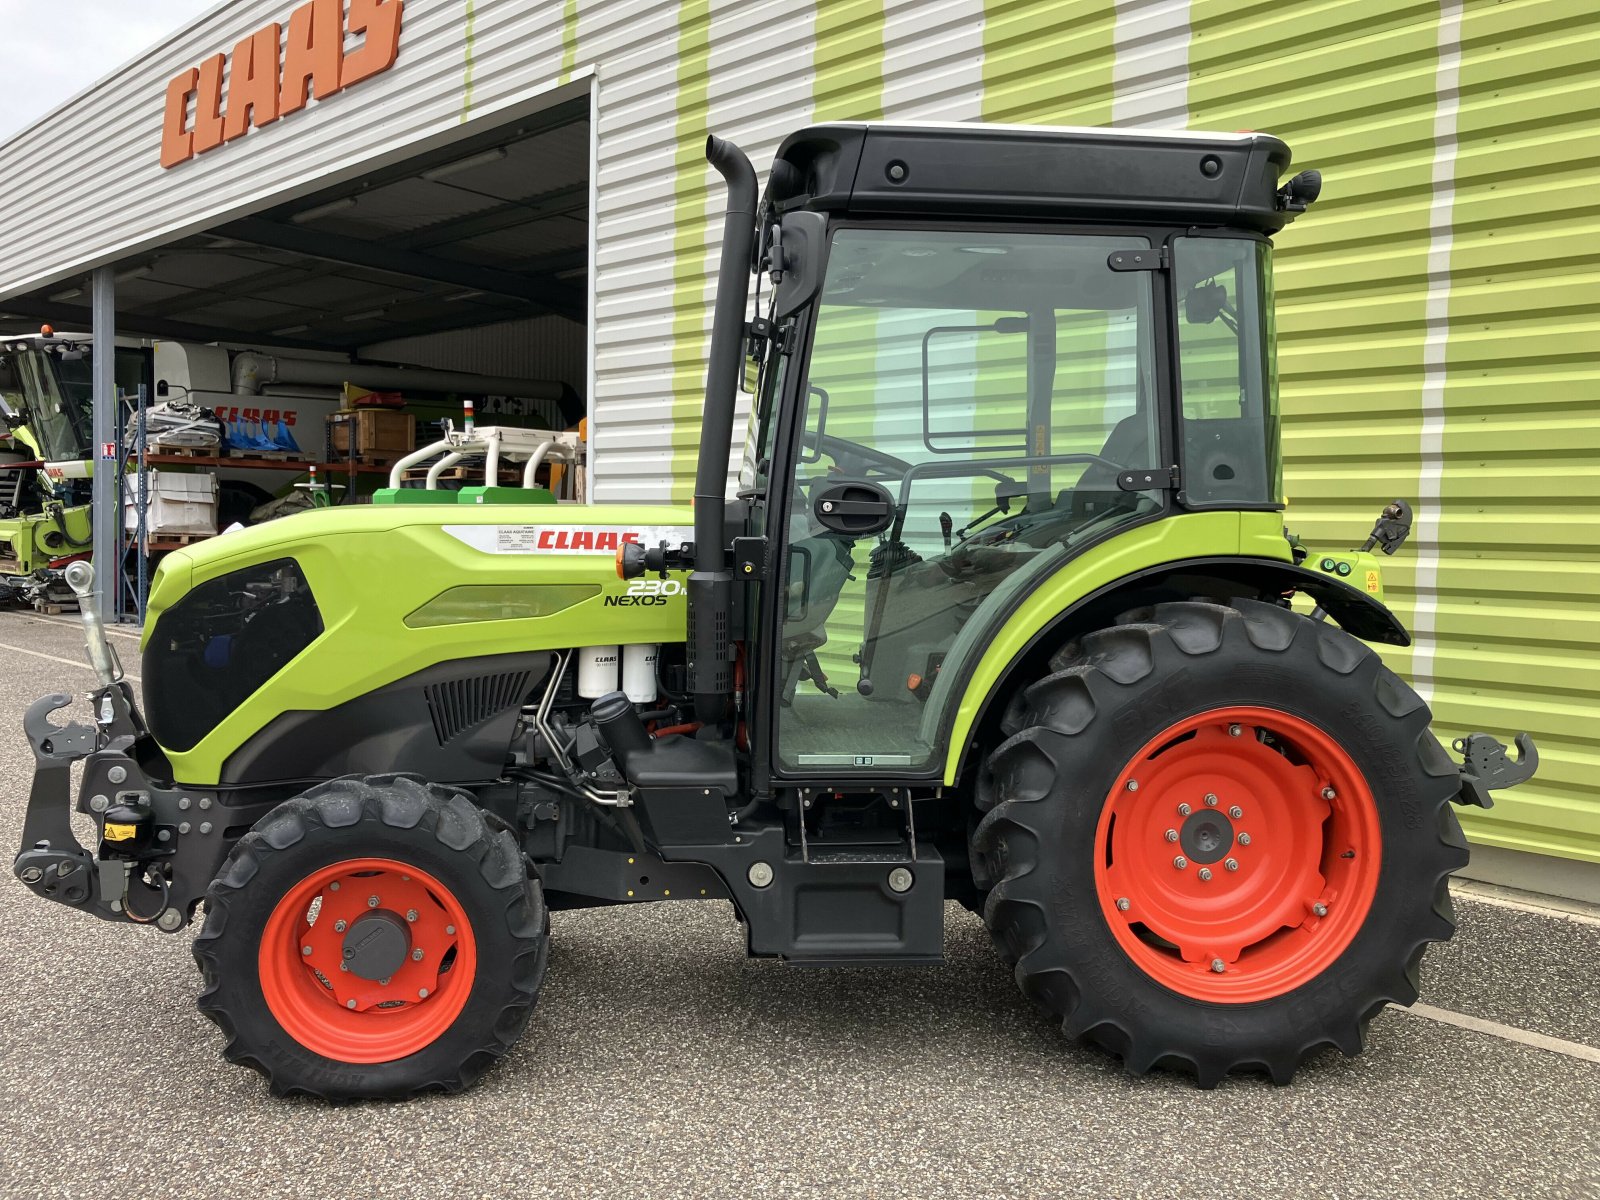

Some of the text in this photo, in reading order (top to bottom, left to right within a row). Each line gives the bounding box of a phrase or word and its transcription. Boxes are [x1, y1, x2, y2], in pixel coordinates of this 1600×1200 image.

[160, 0, 402, 169] CLAAS
[214, 406, 297, 426] CLAAS
[604, 595, 668, 606] NEXOS
[595, 655, 617, 663] CLAAS
